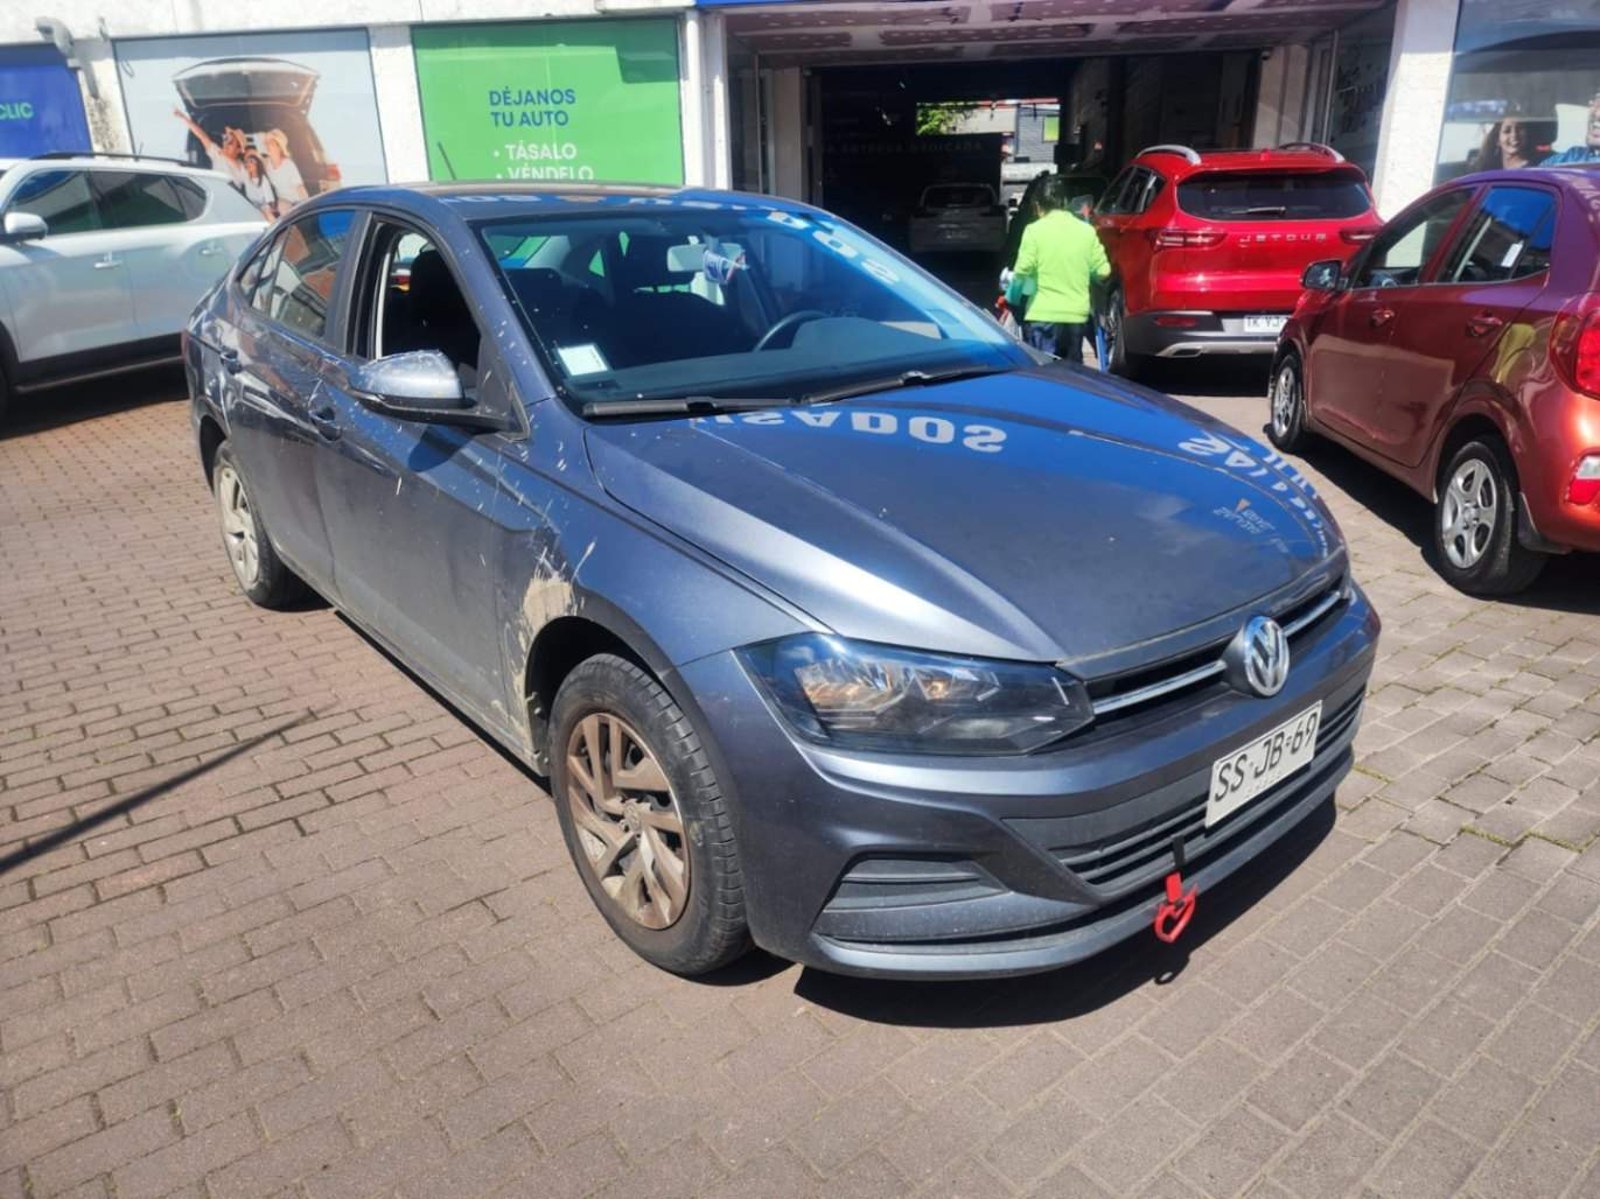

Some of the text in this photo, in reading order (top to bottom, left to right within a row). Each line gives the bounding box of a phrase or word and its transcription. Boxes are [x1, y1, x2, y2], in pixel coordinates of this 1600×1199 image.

[489, 86, 576, 106] DÉJANOS
[490, 110, 569, 127] TU AUTO
[504, 140, 577, 160] TÁSALO
